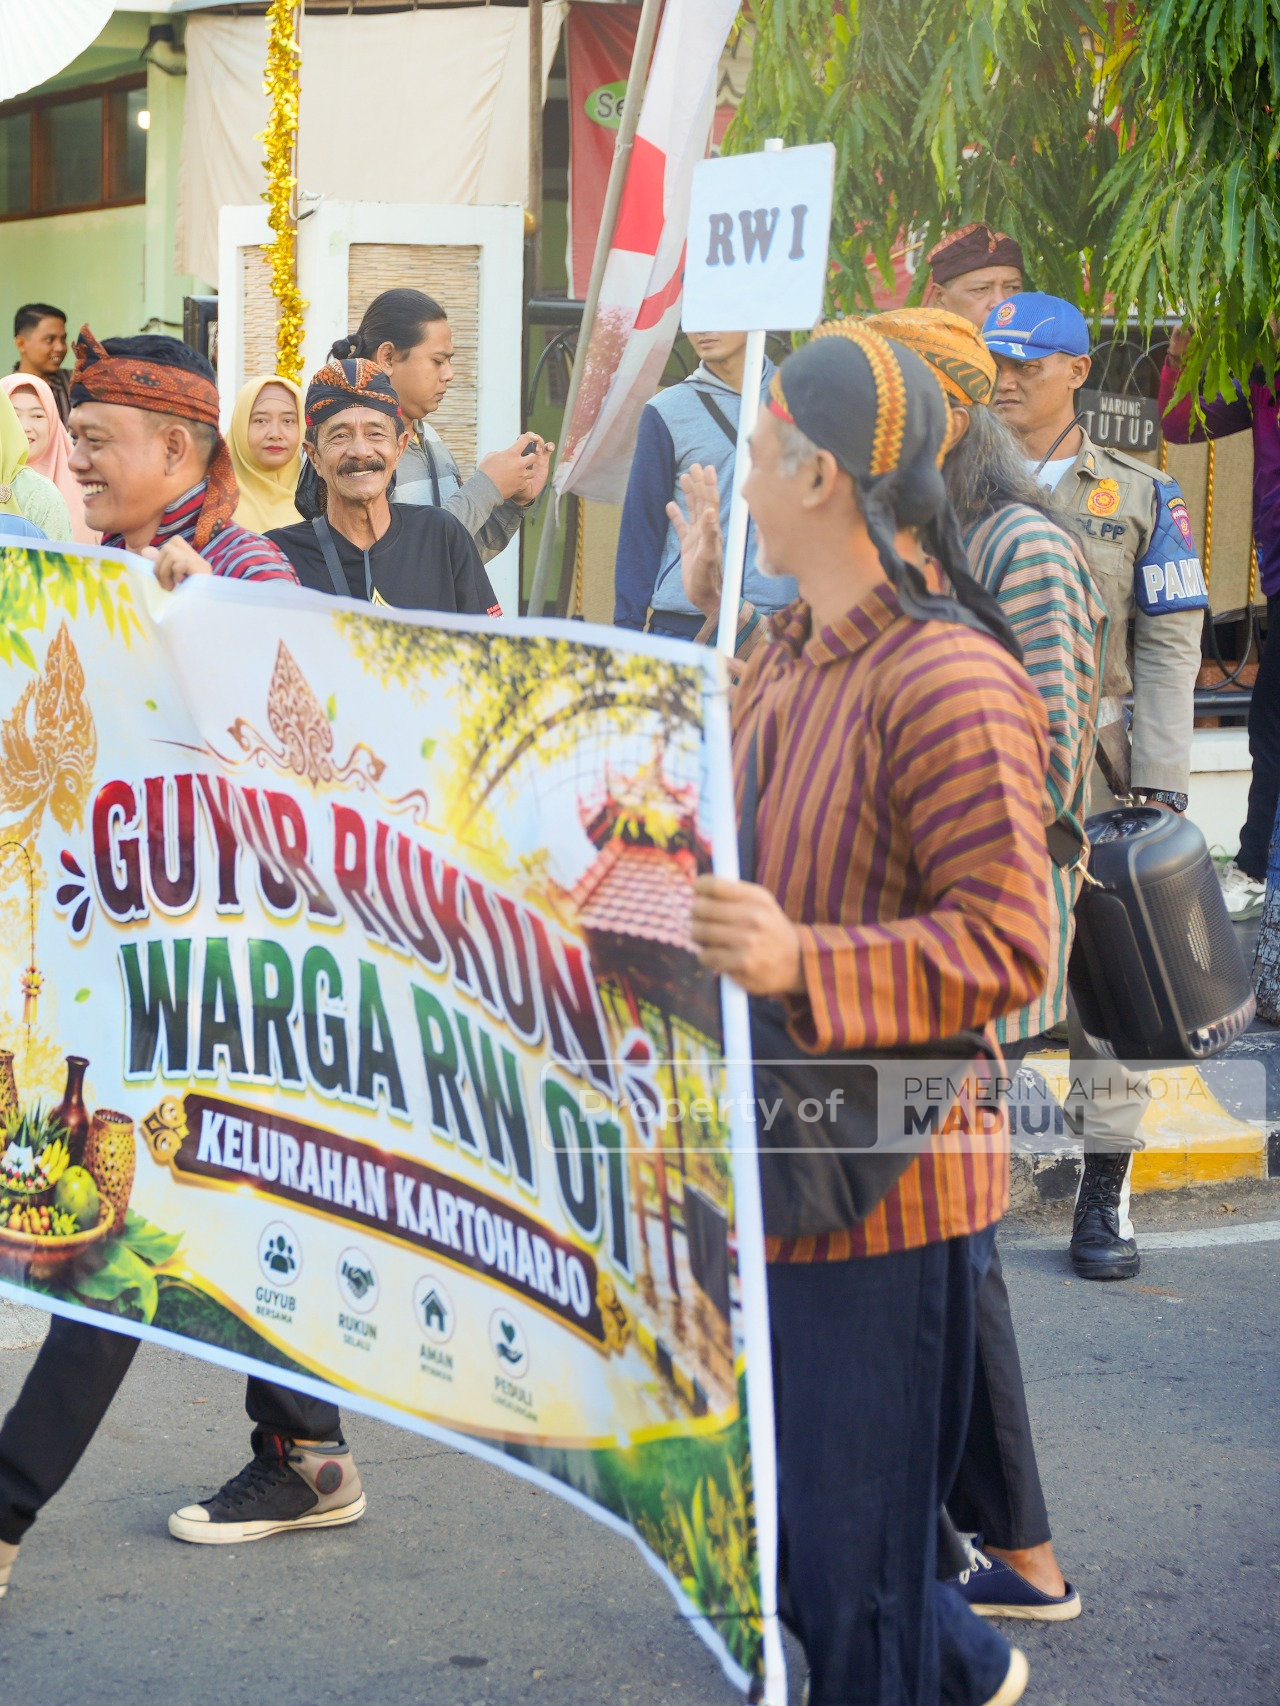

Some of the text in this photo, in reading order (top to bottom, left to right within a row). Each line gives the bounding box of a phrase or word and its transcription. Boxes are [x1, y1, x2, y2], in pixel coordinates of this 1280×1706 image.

[1100, 396, 1141, 417] WARUNG
[1084, 410, 1154, 446] TUTUP
[1101, 522, 1127, 540] PP
[92, 772, 618, 1096] GUYUB RUKUN
[119, 936, 635, 1280] WARGA RW 01
[195, 1108, 594, 1320] KELURAHAN KARTOHARJO
[256, 1286, 297, 1312] GUYUB
[256, 1305, 293, 1324] BERSAMA
[338, 1312, 378, 1340] RUKUN
[420, 1343, 454, 1370] AMAN
[494, 1375, 534, 1408] PEDULI
